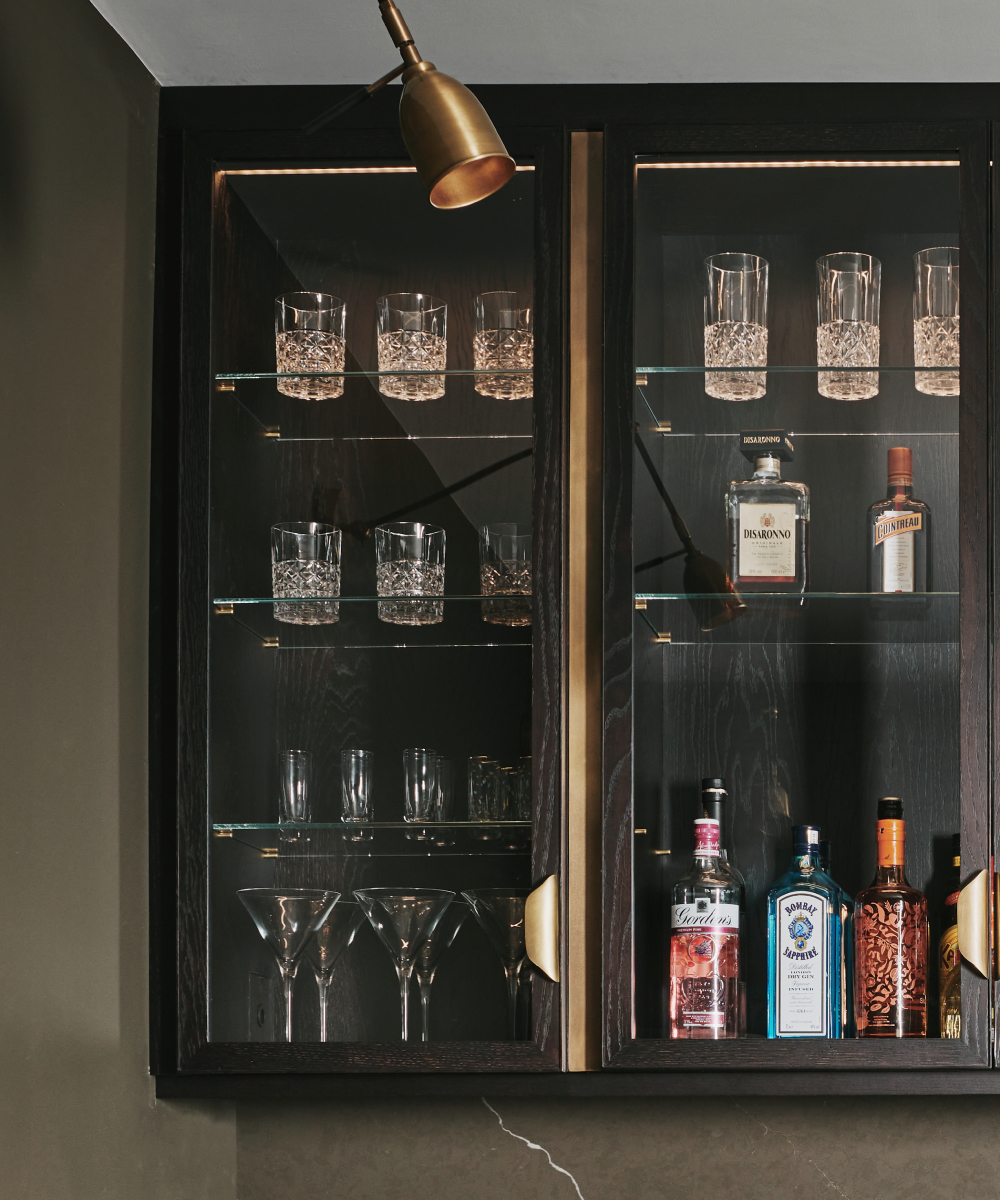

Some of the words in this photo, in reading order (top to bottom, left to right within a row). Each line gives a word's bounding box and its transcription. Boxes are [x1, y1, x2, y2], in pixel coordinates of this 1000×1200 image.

[743, 436, 781, 444] DISARONNO
[743, 529, 791, 540] DISARONNO
[877, 516, 919, 540] COINTREAU
[785, 902, 818, 916] BOMBAY
[675, 907, 732, 926] Gordon's
[783, 947, 818, 960] SAPPHIRE
